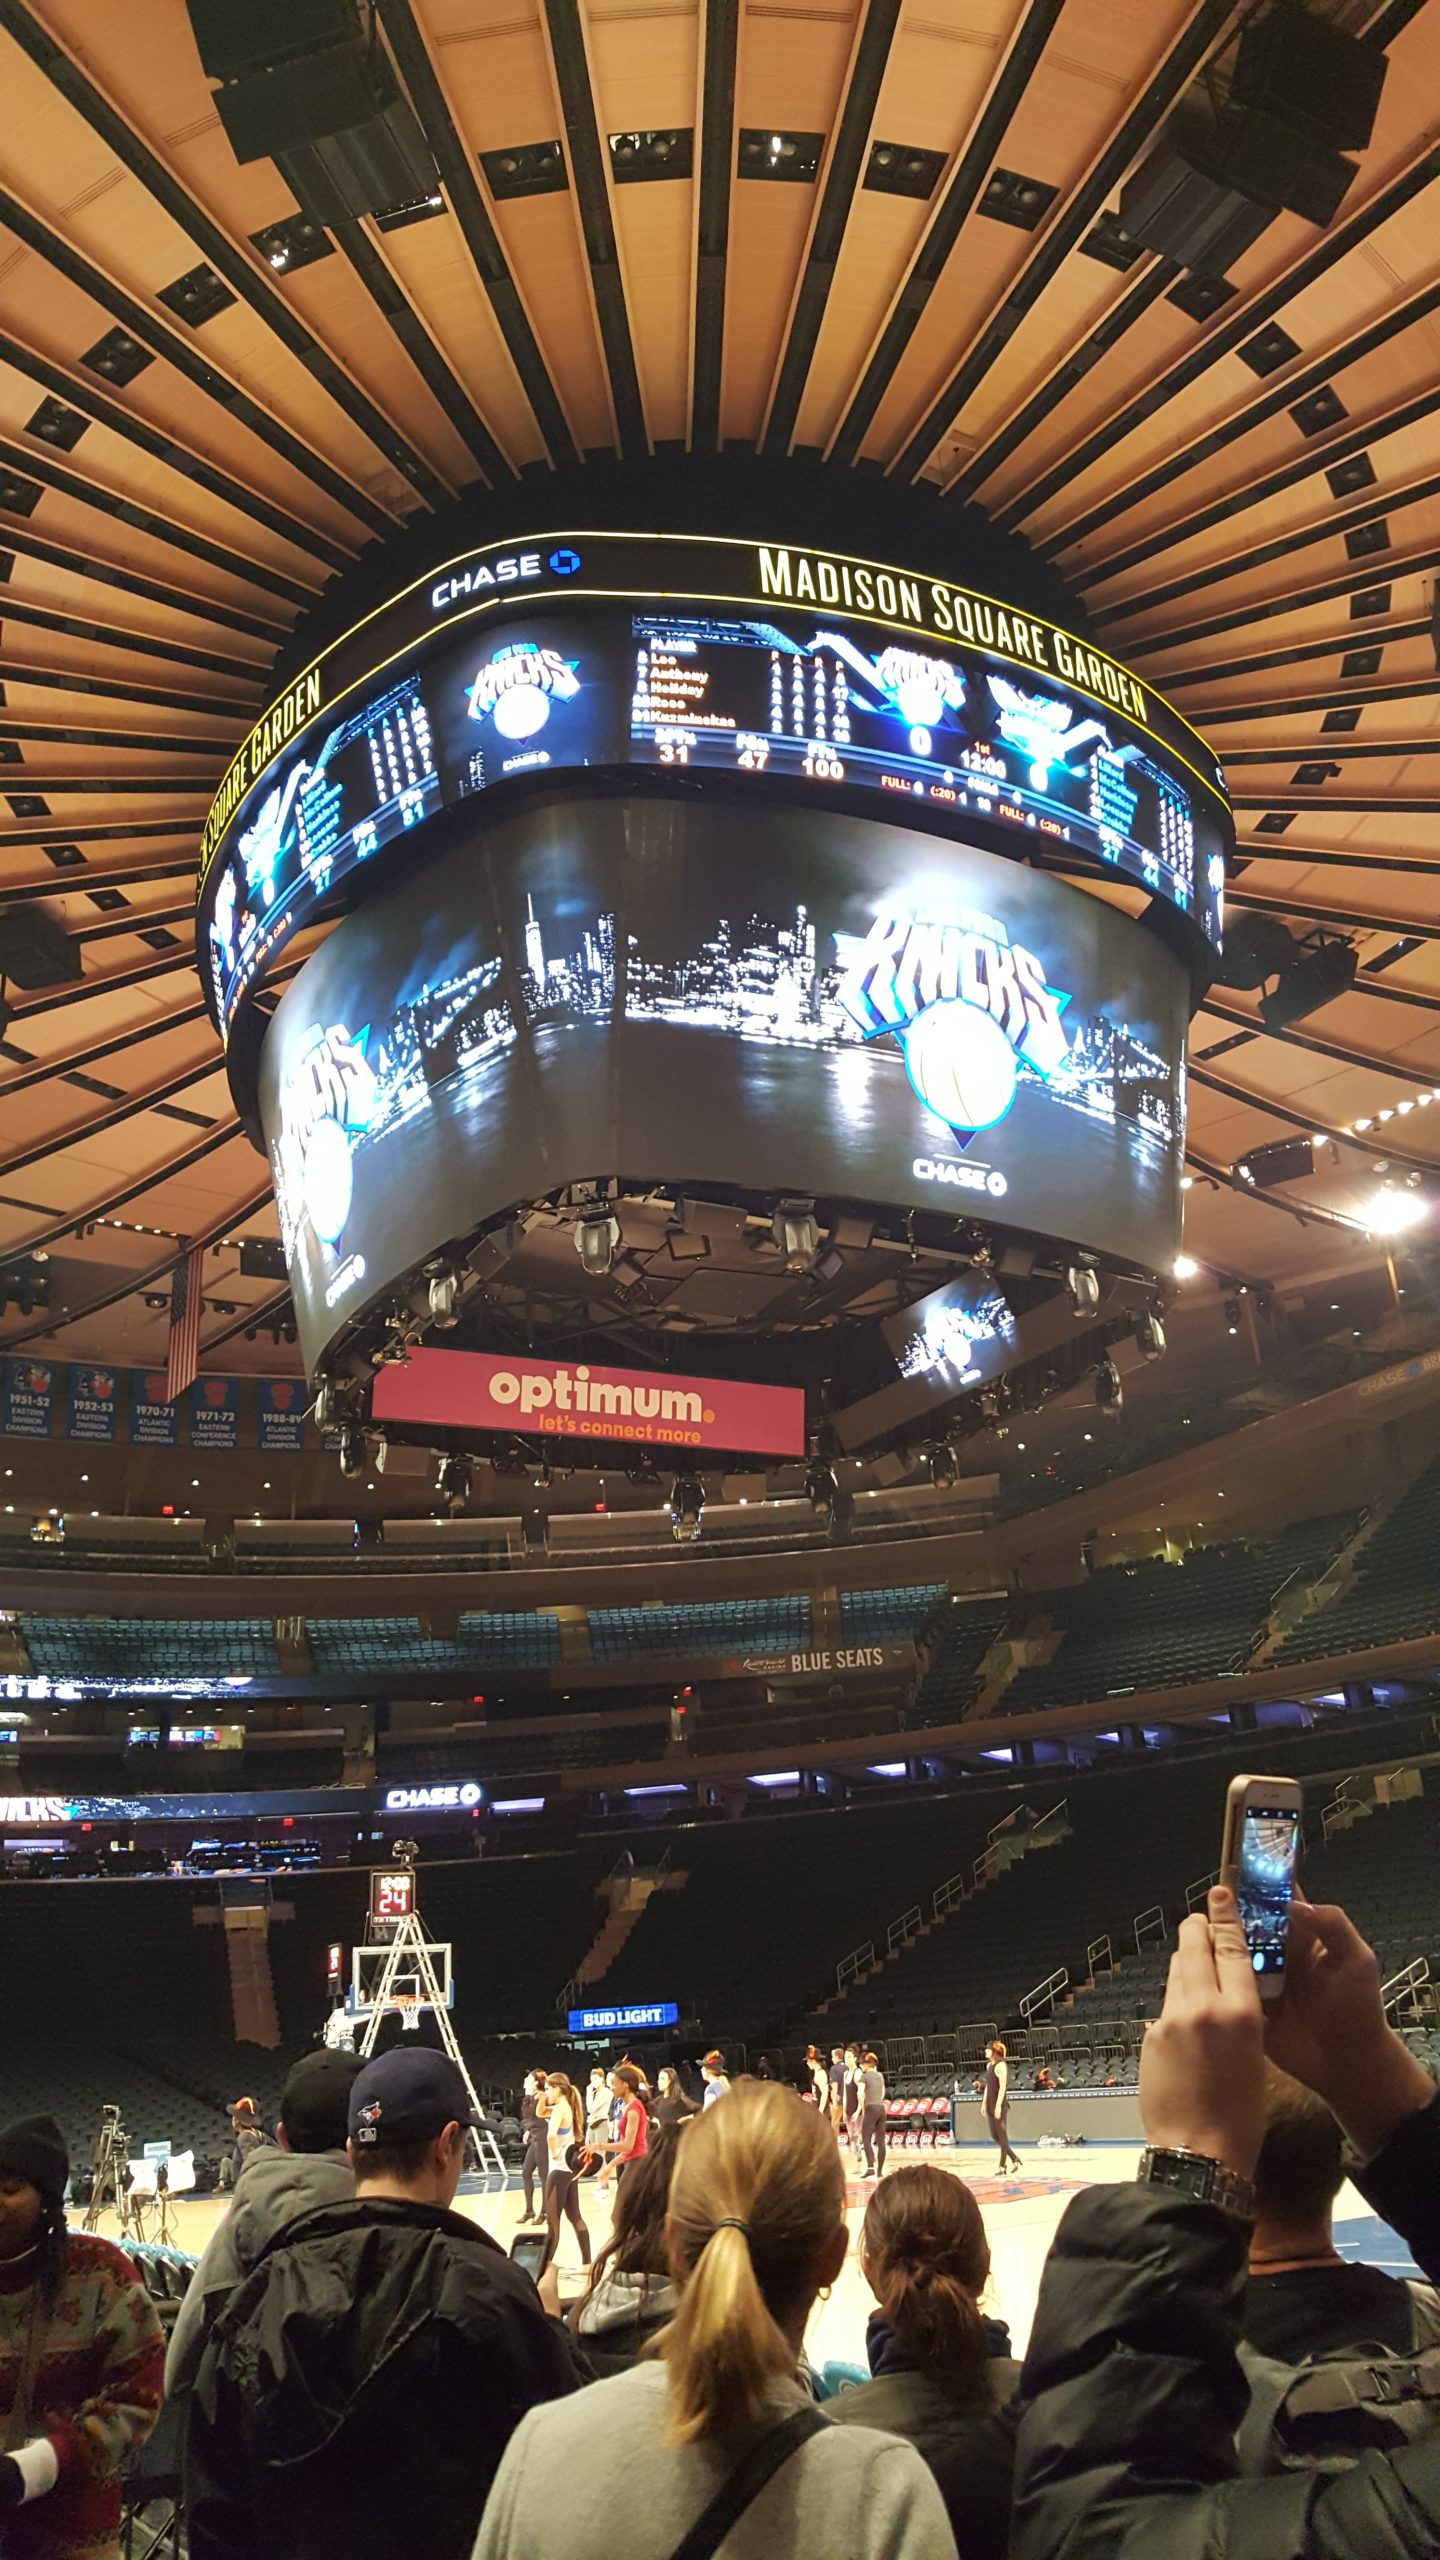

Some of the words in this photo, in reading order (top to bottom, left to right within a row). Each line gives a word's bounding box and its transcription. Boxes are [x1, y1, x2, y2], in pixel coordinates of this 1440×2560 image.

[432, 554, 542, 608] CHASE
[759, 547, 923, 624] MADISON
[931, 584, 1049, 668] SQUARE
[1053, 631, 1148, 723] GARDEN
[650, 653, 677, 666] Lee
[650, 667, 709, 684] Anthony
[650, 681, 704, 698] Holiday
[650, 696, 686, 710] Rose
[650, 710, 736, 728] Kuzminskas
[910, 726, 932, 755] 0
[208, 750, 249, 854] SQUARE
[251, 668, 320, 775] GARDEN
[659, 744, 688, 763] 31
[737, 751, 768, 770] 47
[802, 757, 844, 780] 100
[960, 749, 1007, 779] 12:00
[881, 775, 911, 791] FULL:
[1000, 804, 1024, 821] FULL:
[357, 833, 378, 859] 44
[1102, 842, 1120, 864] 27
[315, 868, 332, 896] 27
[839, 914, 1070, 1080] KNICKS
[913, 1158, 986, 1191] CHASE
[1359, 1367, 1407, 1397] CHASE
[10, 1393, 50, 1407] 1951-52
[74, 1400, 114, 1412] 1952-53
[12, 1408, 45, 1417] EASTERN
[76, 1413, 109, 1422] EASTERN
[136, 1405, 175, 1417] 1970-71
[196, 1411, 235, 1422] 1971-72
[5, 1424, 48, 1434] CHAMPIONS
[138, 1419, 171, 1427] ATLANTIC
[140, 1426, 169, 1435] DIVISION
[198, 1423, 230, 1431] EASTERN
[265, 1425, 297, 1433] ATLANTIC
[539, 1413, 577, 1434] let's
[580, 1420, 653, 1440] connect
[656, 1427, 701, 1444] more
[70, 1429, 112, 1439] CHAMPIONS
[133, 1434, 174, 1443] CHAMPIONS
[191, 1431, 237, 1440] CONFERENCE
[193, 1439, 234, 1448] CHAMPIONS
[262, 1441, 301, 1449] CHAMPIONS
[791, 1651, 832, 1673] BLUE
[836, 1647, 884, 1669] SEATS
[386, 1786, 460, 1809] CHASE
[379, 1890, 406, 1913] 24
[583, 2012, 616, 2028] BUD
[617, 2008, 662, 2025] LIGHT
